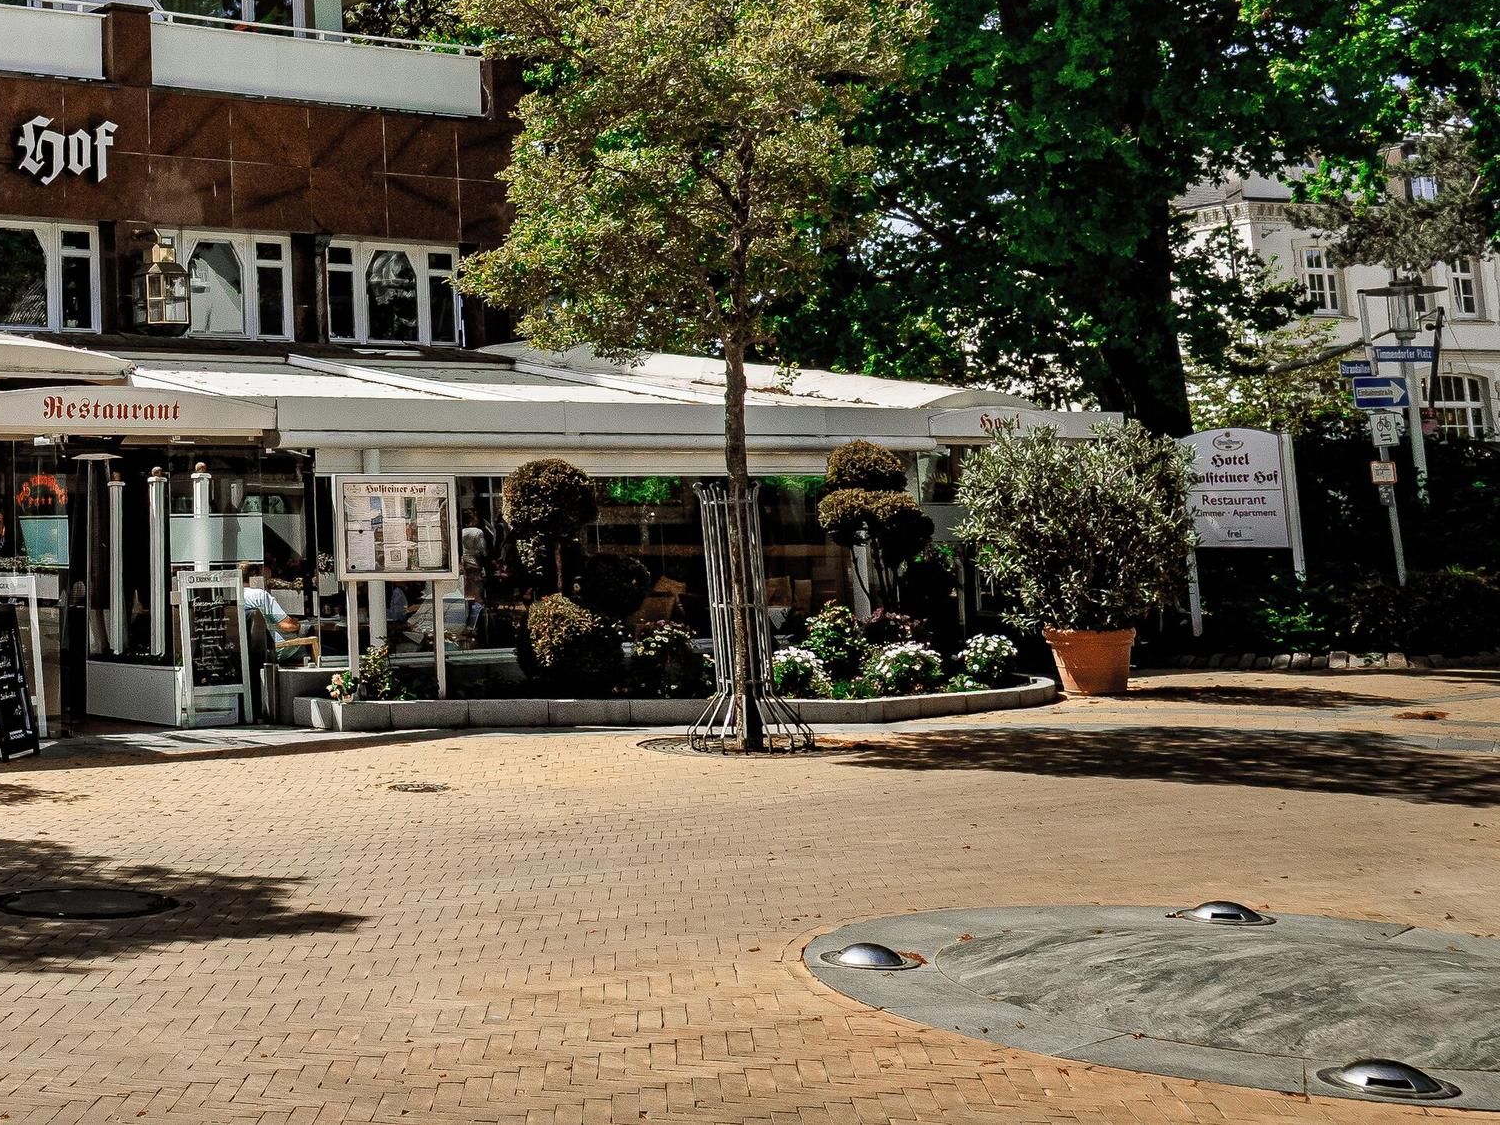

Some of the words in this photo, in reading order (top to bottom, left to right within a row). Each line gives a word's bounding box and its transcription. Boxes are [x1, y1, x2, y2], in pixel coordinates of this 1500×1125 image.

[18, 115, 118, 185] Hof
[1417, 348, 1432, 359] Platz
[43, 395, 180, 420] Restaurant
[1211, 453, 1250, 467] Hotel
[1253, 470, 1278, 485] Hof
[409, 484, 427, 495] Hof
[1202, 495, 1267, 506] Restaurant
[1195, 509, 1226, 517] Zimmer
[1233, 509, 1277, 518] Apartment
[1227, 529, 1242, 538] frei
